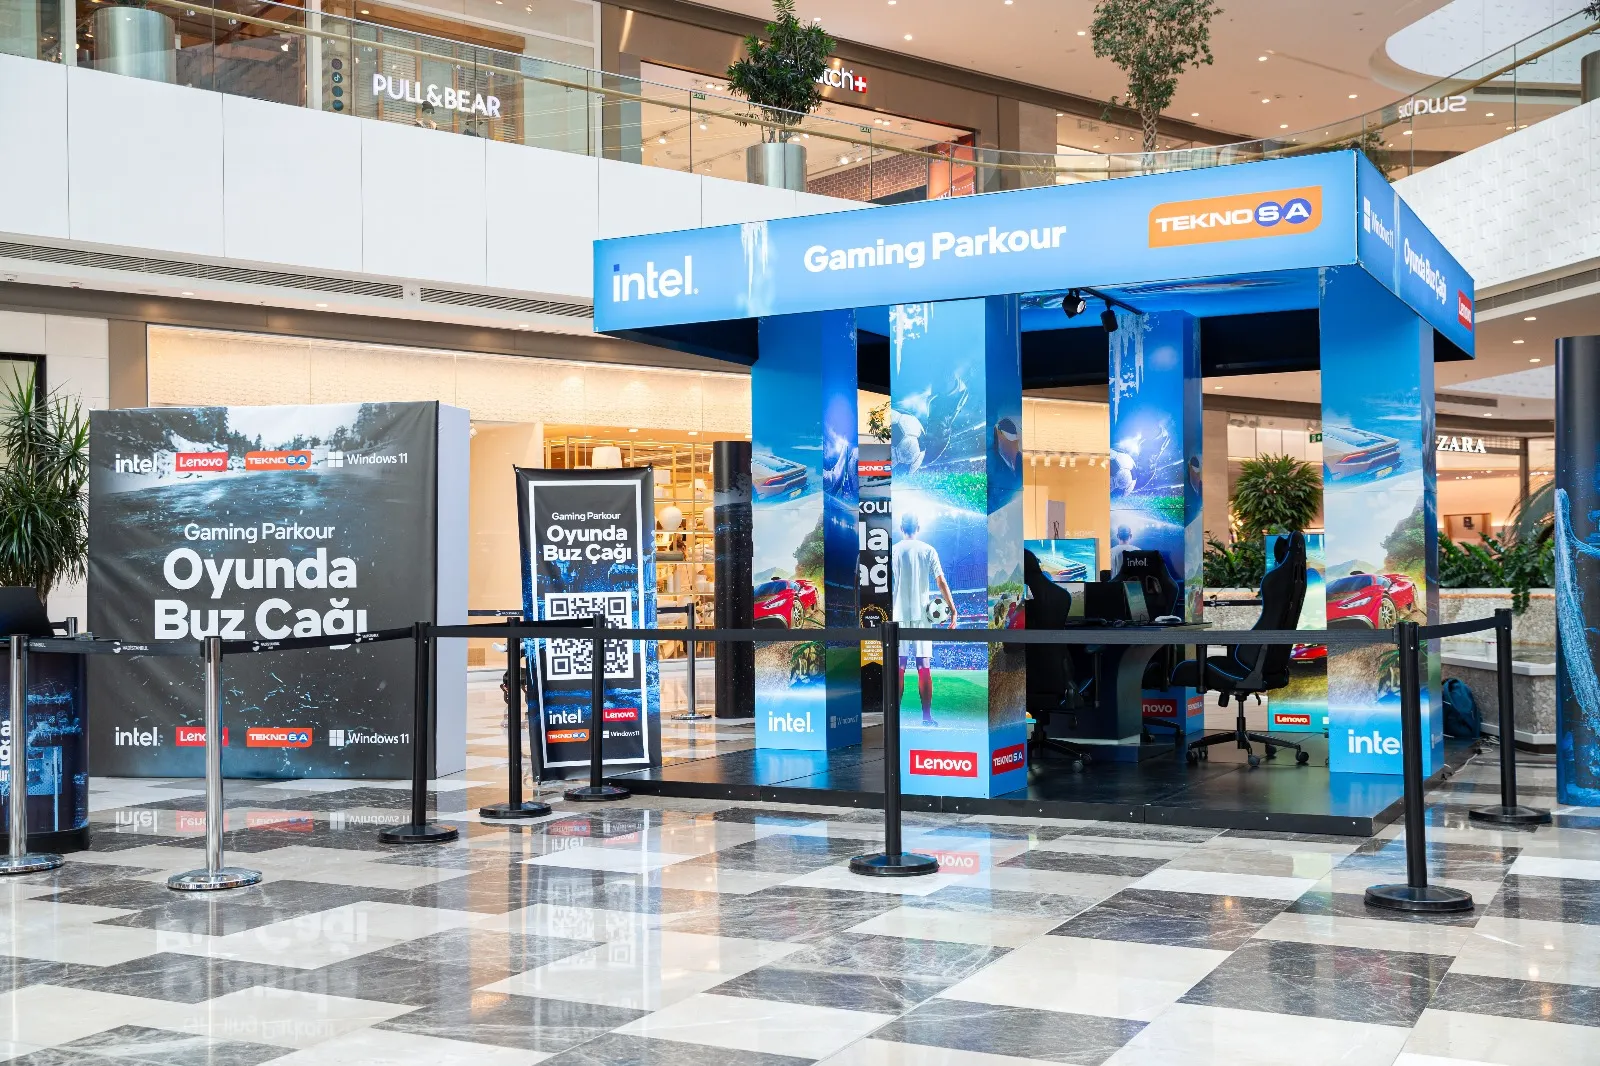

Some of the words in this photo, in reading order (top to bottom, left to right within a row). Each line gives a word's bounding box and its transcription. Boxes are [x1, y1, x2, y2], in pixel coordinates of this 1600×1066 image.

[373, 73, 501, 118] PULL&BEAR
[1156, 202, 1310, 232] TEKNOSA
[1371, 209, 1390, 247] Windows
[803, 238, 926, 273] Gaming
[932, 225, 1067, 260] Parkour
[1404, 237, 1425, 281] Oyunda
[1425, 258, 1436, 291] Buz
[1459, 296, 1473, 324] Lenovo
[1437, 434, 1487, 454] ZARA
[180, 456, 224, 468] Lenovo
[247, 455, 308, 466] TEKNOSA
[346, 453, 397, 466] Windows
[398, 452, 408, 465] 11
[551, 511, 586, 522] Gaming
[587, 511, 621, 520] Parkour
[184, 523, 258, 544] Gaming
[262, 522, 336, 541] Parkour
[546, 524, 628, 546] Oyunda
[543, 544, 583, 562] Buz
[585, 542, 633, 565] Çağı
[163, 547, 358, 600] Oyunda
[155, 599, 246, 641] Buz
[1142, 703, 1173, 713] novo
[1276, 715, 1308, 723] Lenovo
[248, 733, 309, 742] TEKNOSA
[347, 732, 398, 744] Windows
[400, 732, 409, 744] 11
[1348, 729, 1403, 755] inte
[915, 754, 973, 772] Lenovo
[992, 752, 1024, 767] TEKNOSA
